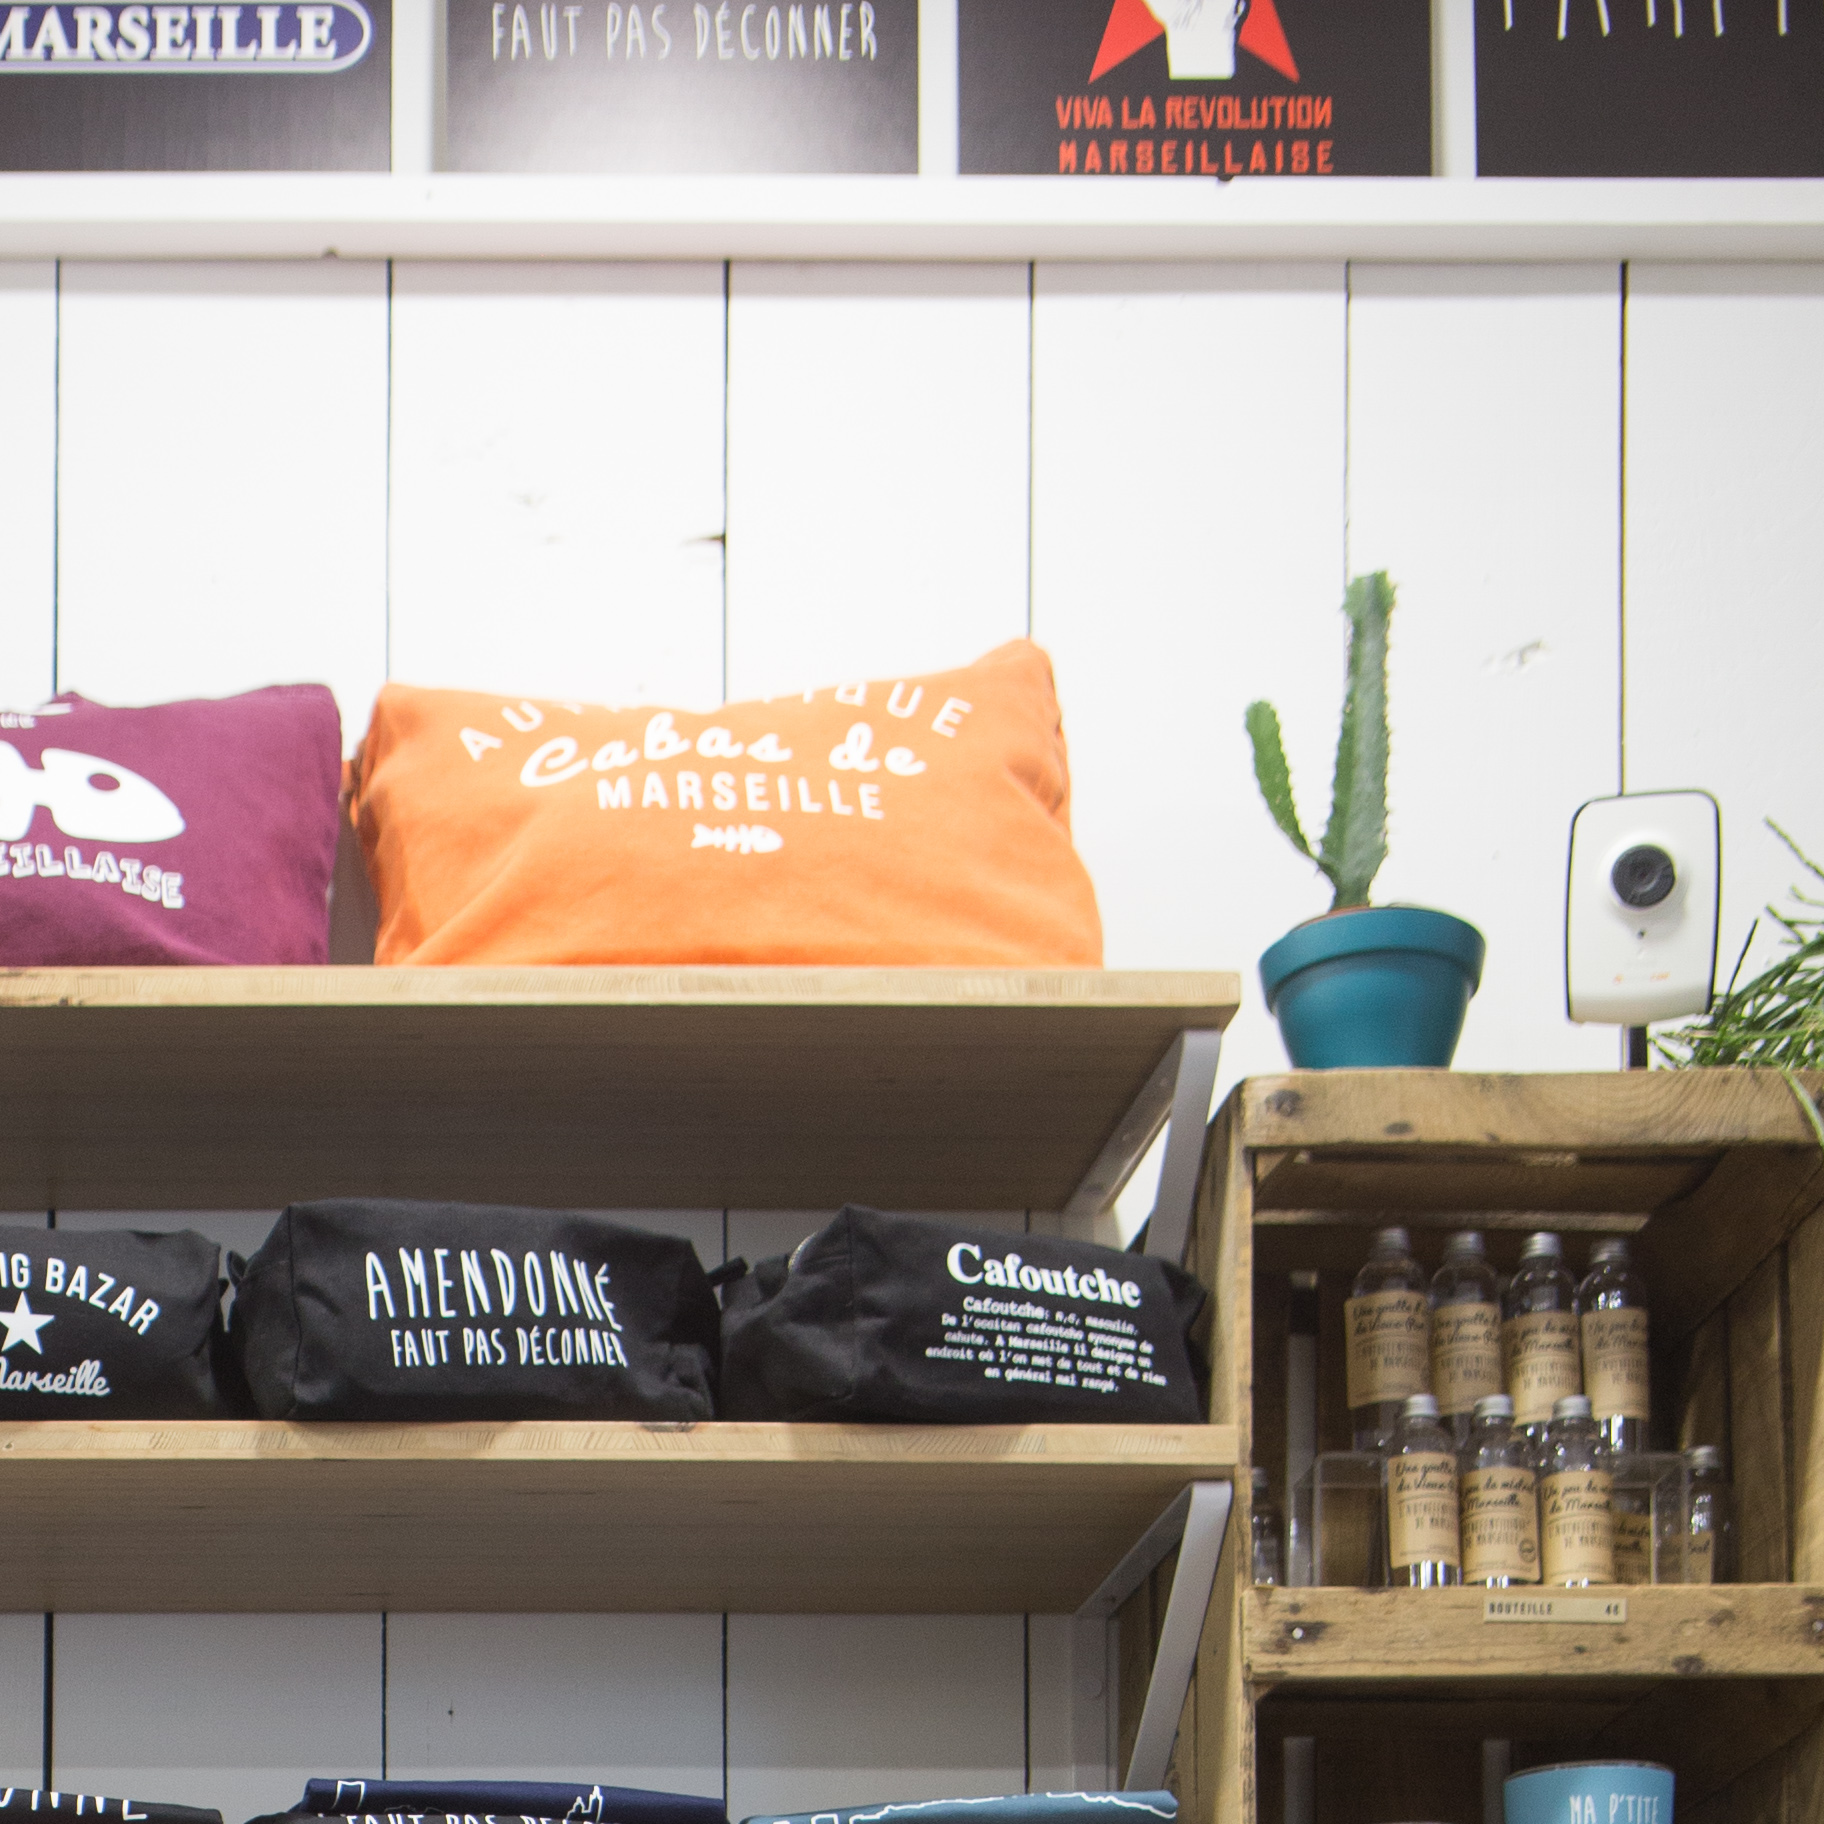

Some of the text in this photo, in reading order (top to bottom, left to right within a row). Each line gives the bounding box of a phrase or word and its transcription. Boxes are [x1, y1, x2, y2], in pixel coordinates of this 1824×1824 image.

[491, 0, 878, 61] FAUT PAS DÉCONNER
[1056, 95, 1113, 130] VIVA
[1122, 95, 1157, 130] LA
[1059, 140, 1335, 174] MARSEILLAISE
[519, 711, 926, 788] Cabas de
[597, 771, 885, 820] MARSEILLE
[45, 1256, 161, 1337] BAZAR
[365, 1246, 623, 1333] AMENDONNÉ
[946, 1241, 1142, 1309] Cafoutche
[391, 1324, 629, 1369] FAUT PAS DÉCONNER
